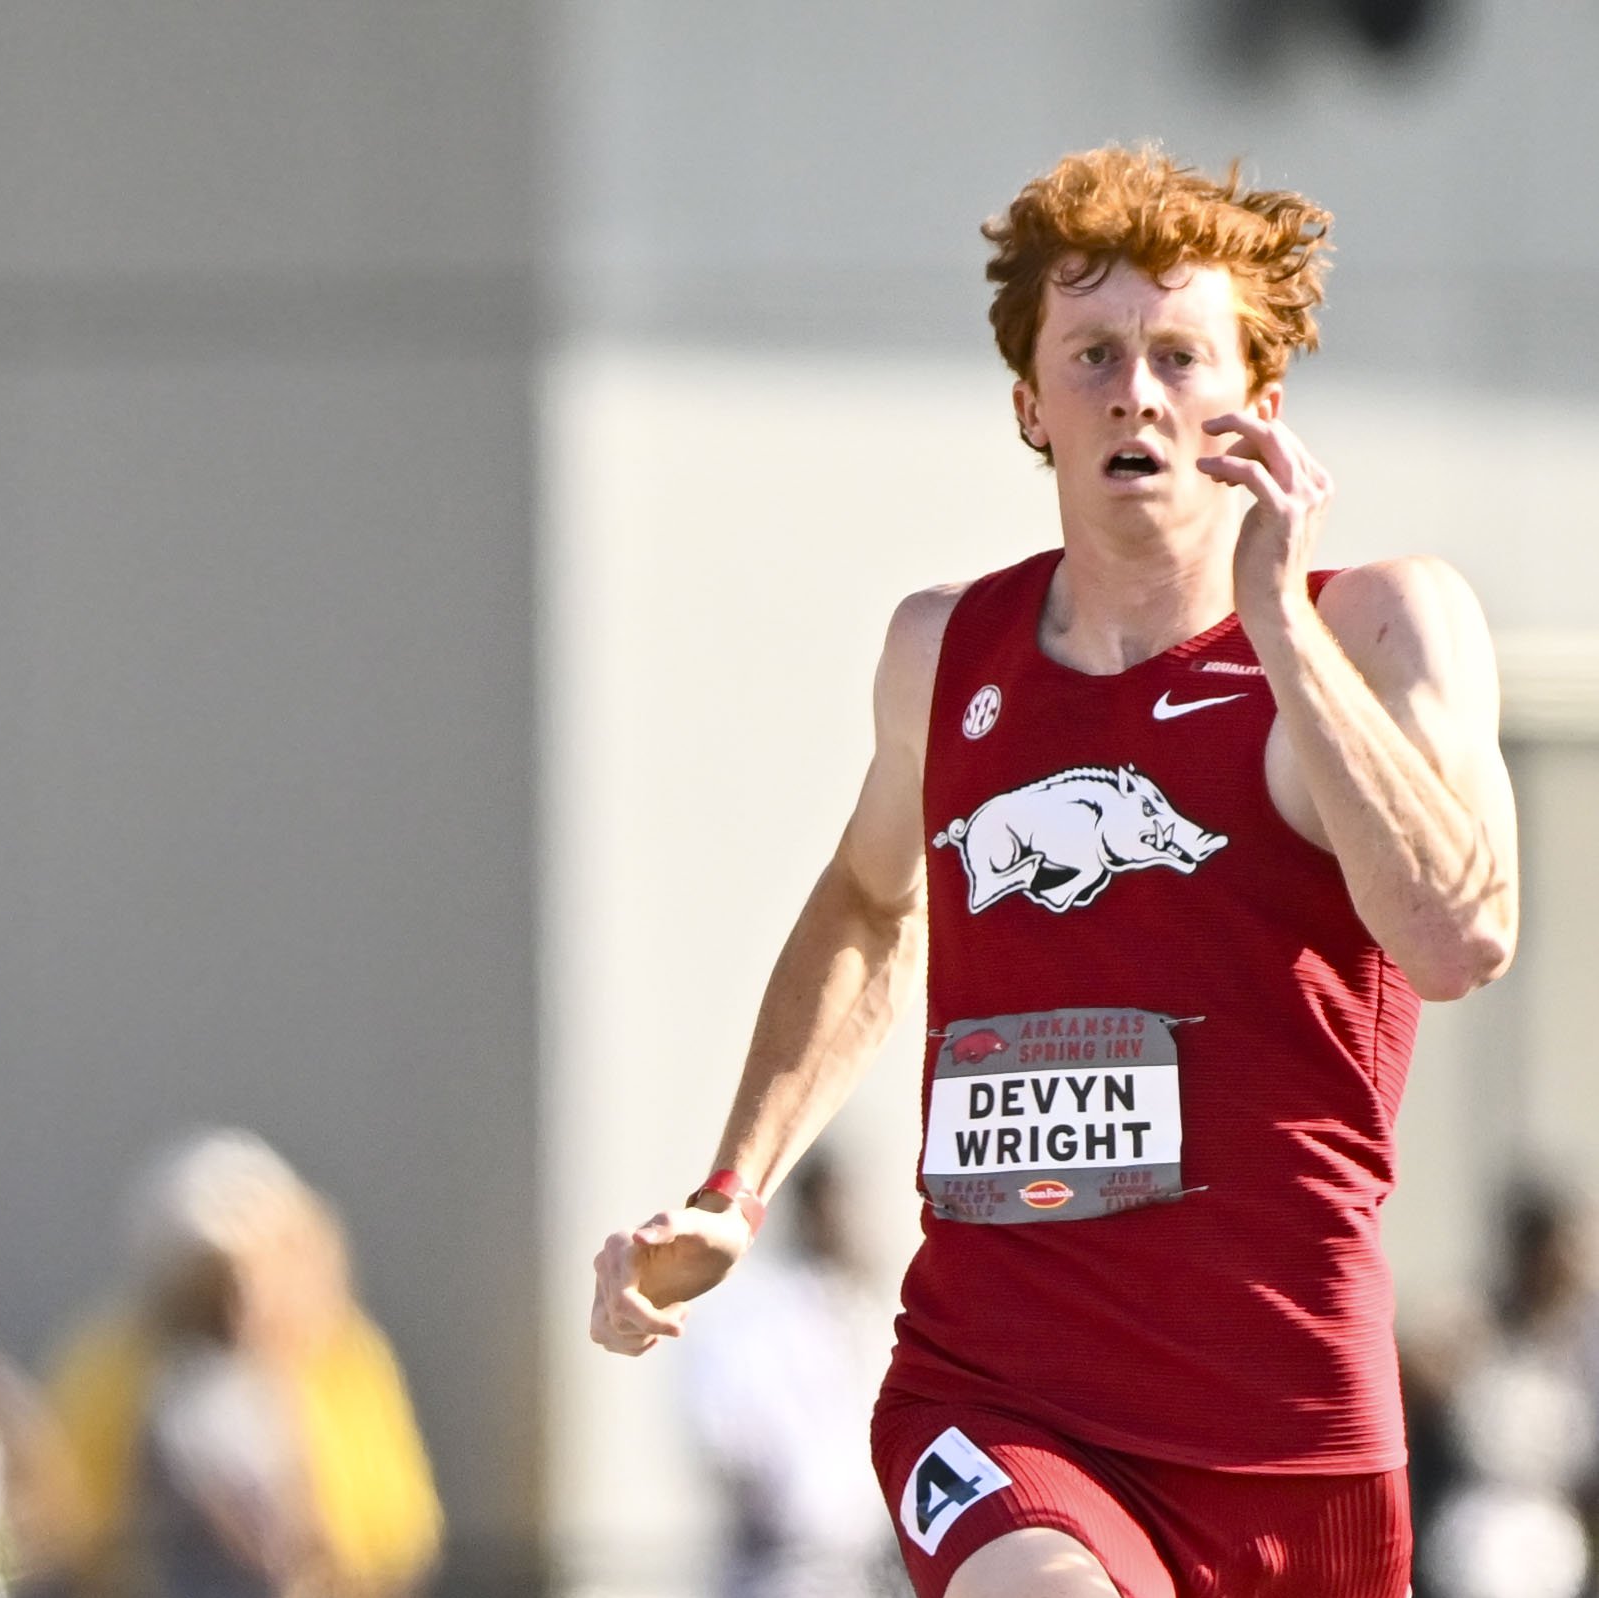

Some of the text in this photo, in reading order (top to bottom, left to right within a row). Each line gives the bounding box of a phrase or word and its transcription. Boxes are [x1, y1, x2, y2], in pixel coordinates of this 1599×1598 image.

[965, 688, 999, 735] SEC
[1020, 1016, 1145, 1039] ARKANSAS
[1019, 1039, 1144, 1063] SPRING INV
[969, 1075, 1136, 1119] DEVYN
[956, 1122, 1152, 1167] WRIGHT
[916, 1451, 983, 1536] 4
